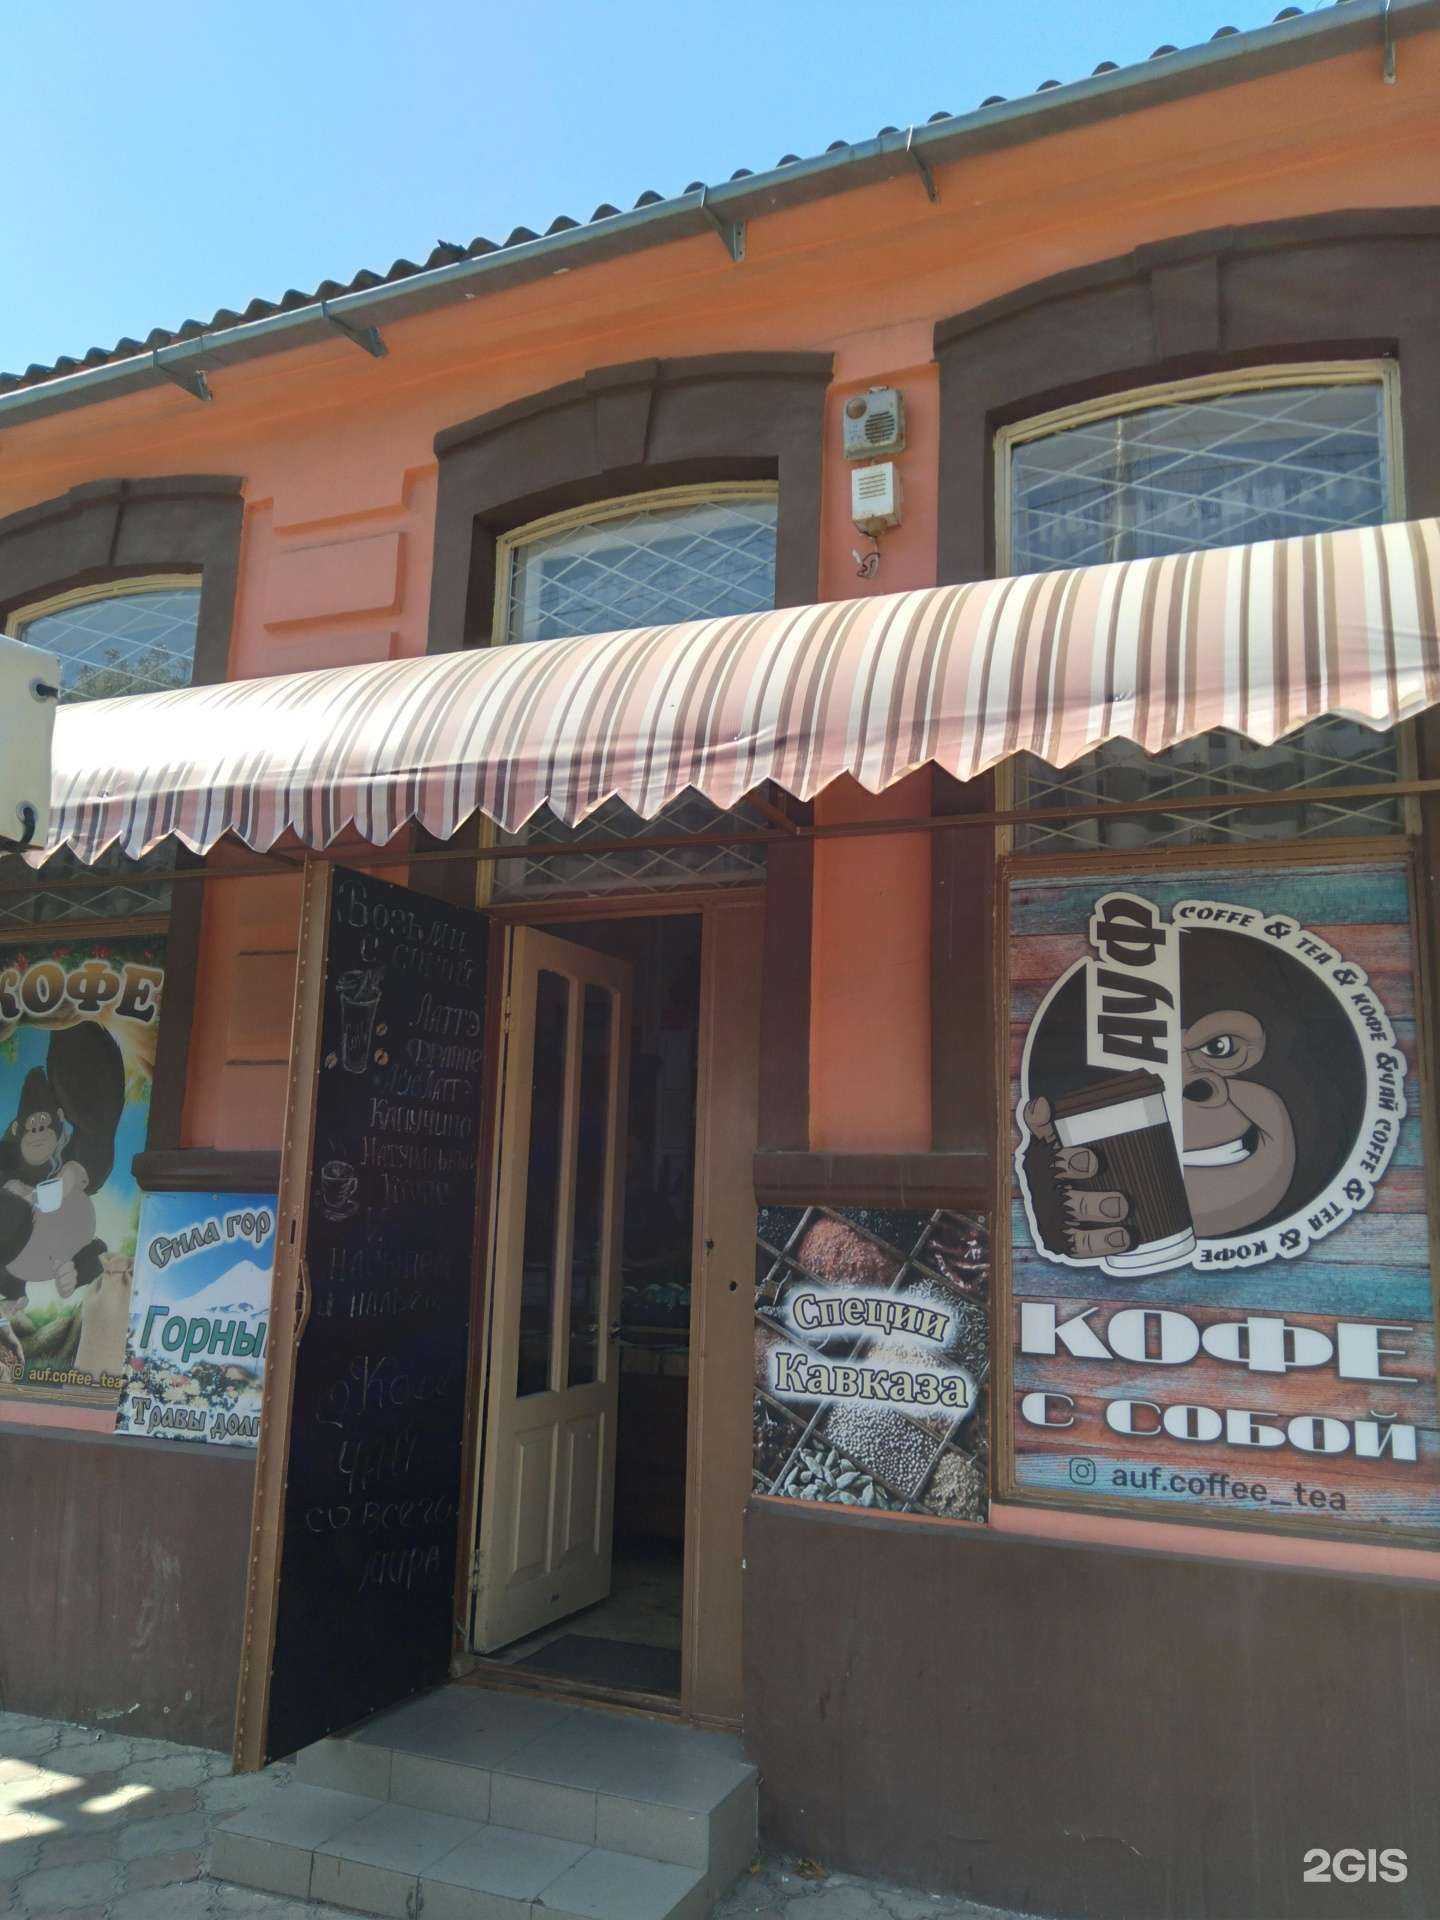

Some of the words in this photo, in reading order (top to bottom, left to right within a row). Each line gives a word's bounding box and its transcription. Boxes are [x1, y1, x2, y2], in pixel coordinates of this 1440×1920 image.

[1178, 905, 1255, 928] COFFE
[1296, 937, 1333, 966] TEA
[1097, 898, 1174, 1065] АУФ
[1351, 992, 1388, 1043] КОФЕ
[1360, 1118, 1393, 1175] COFFE
[148, 1220, 222, 1269] Сила
[226, 1210, 272, 1244] гор
[1309, 1201, 1343, 1233] TEA
[139, 1304, 267, 1364] Горны
[792, 1293, 951, 1343] Специи
[1021, 1301, 1419, 1384] КОФЕ
[28, 1367, 123, 1389] auf.coffee_tea
[775, 1351, 969, 1409] Кавказа
[131, 1396, 208, 1434] Травы
[1021, 1391, 1075, 1428] С
[1105, 1399, 1417, 1462] СОБОЙ
[1111, 1464, 1348, 1512] auf.coffee_tea
